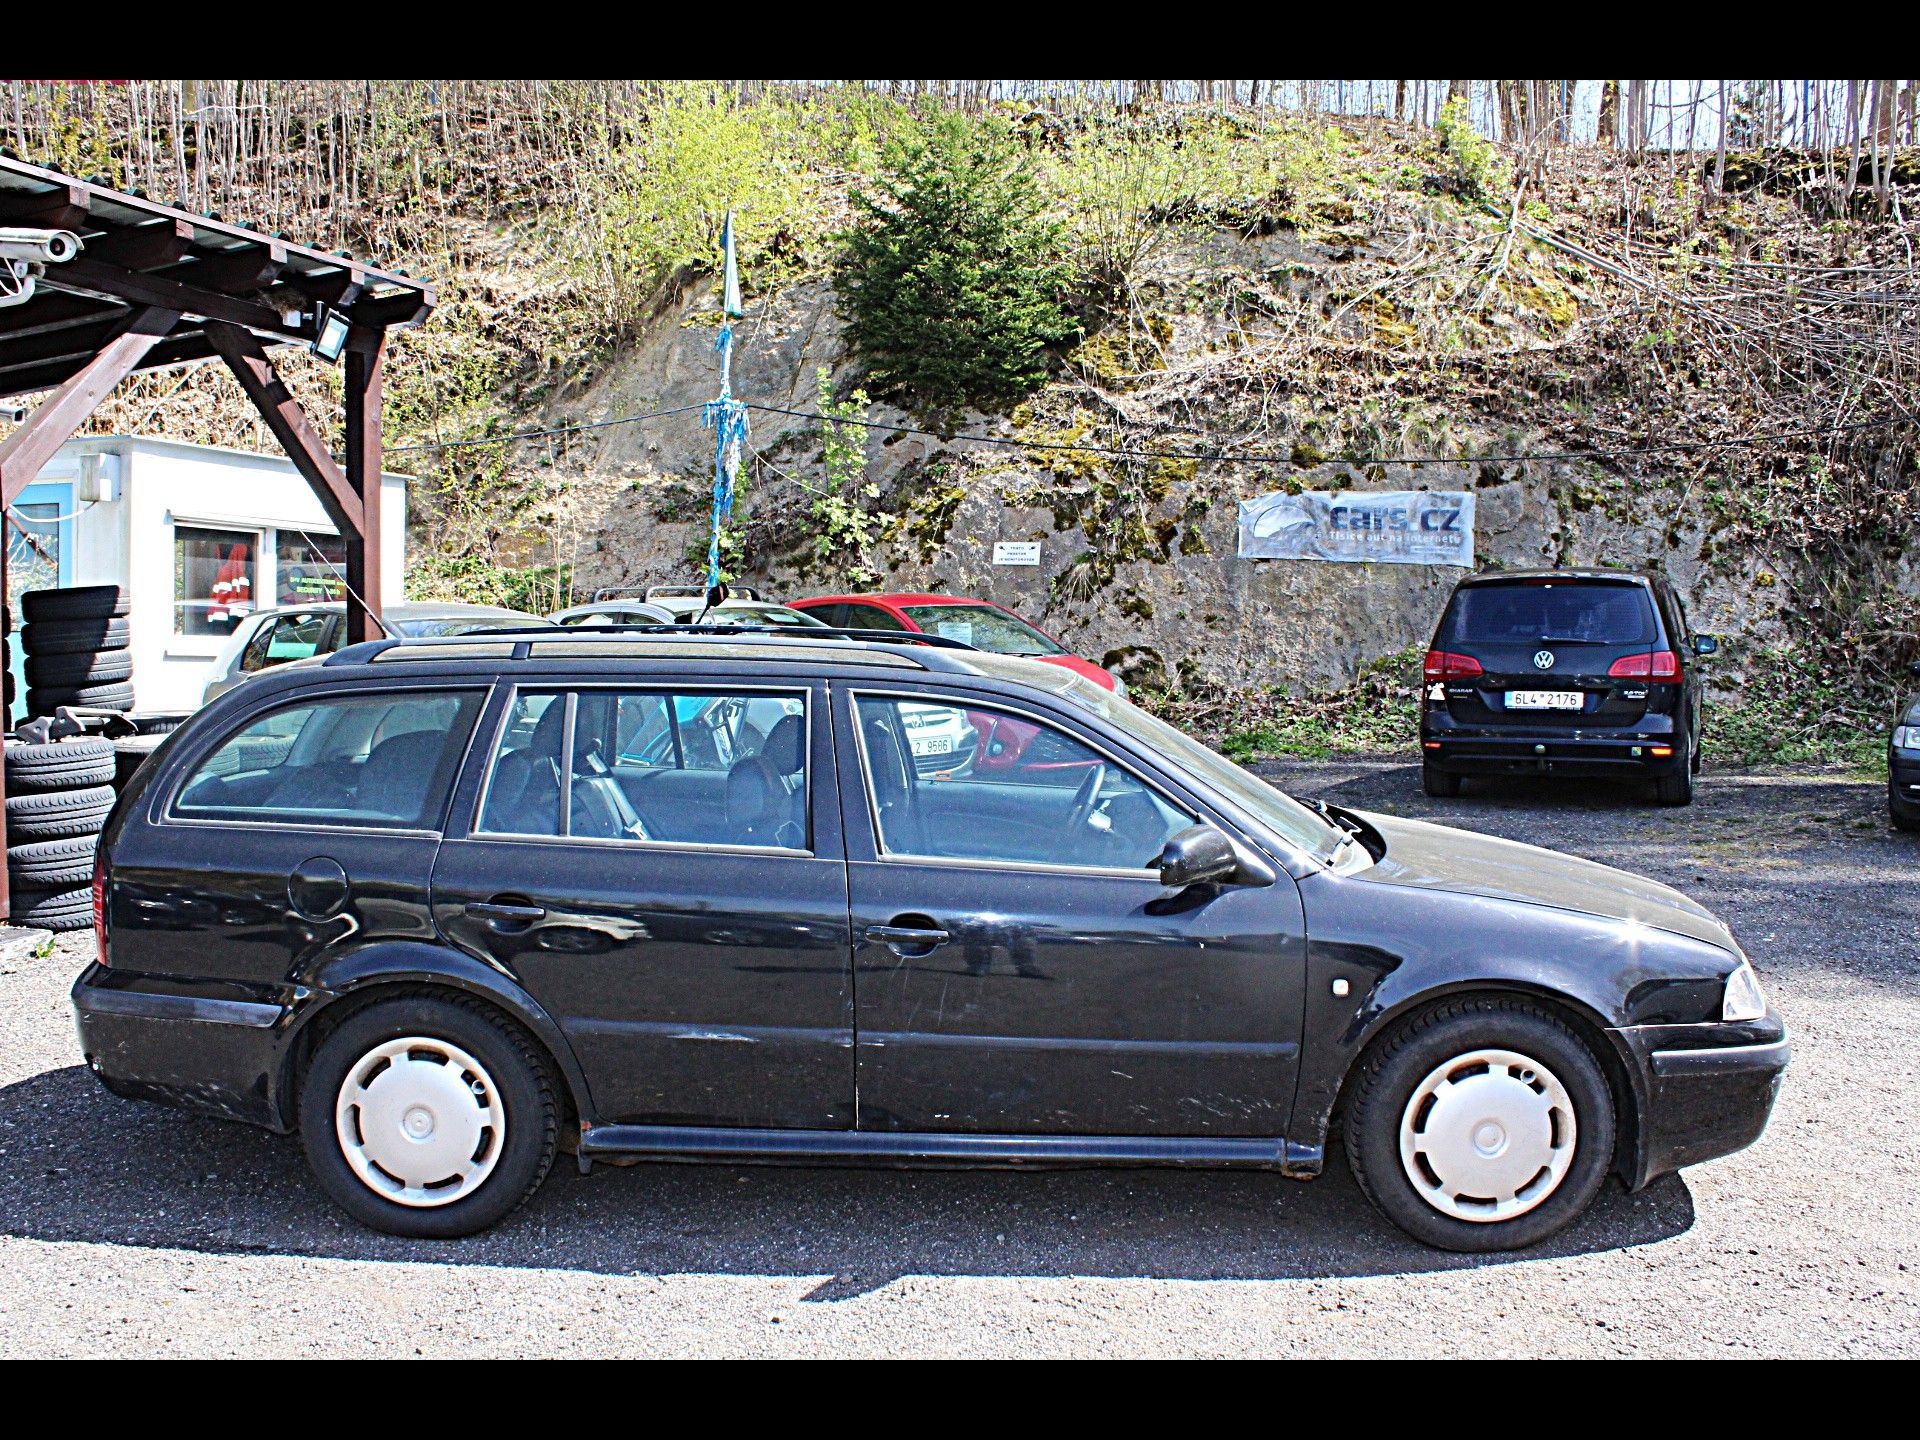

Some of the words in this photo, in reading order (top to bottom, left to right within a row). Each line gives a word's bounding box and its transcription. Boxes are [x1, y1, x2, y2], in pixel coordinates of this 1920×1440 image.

[1330, 507, 1460, 531] cars.cz
[1515, 694, 1537, 705] 6L4
[1547, 694, 1577, 705] 2176
